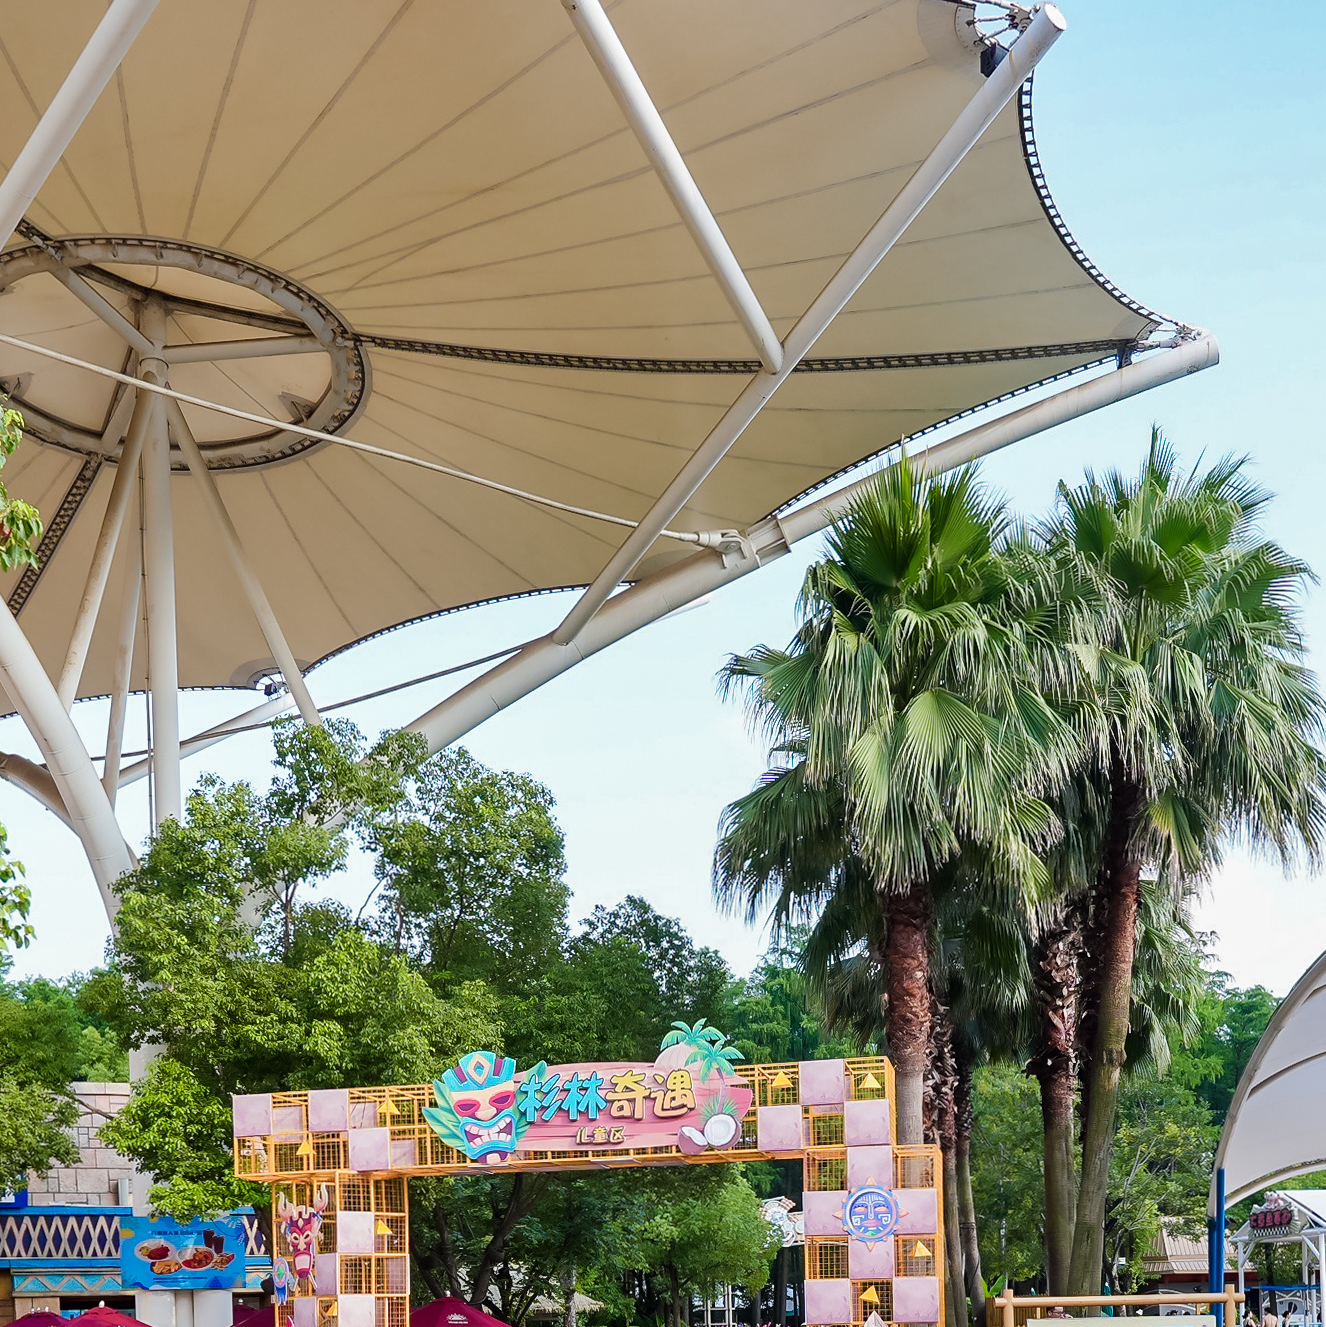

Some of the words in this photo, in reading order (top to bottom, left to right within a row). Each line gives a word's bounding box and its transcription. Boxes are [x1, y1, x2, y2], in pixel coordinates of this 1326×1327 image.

[518, 1069, 696, 1122] 杉林奇遇
[575, 1126, 626, 1145] 儿童区
